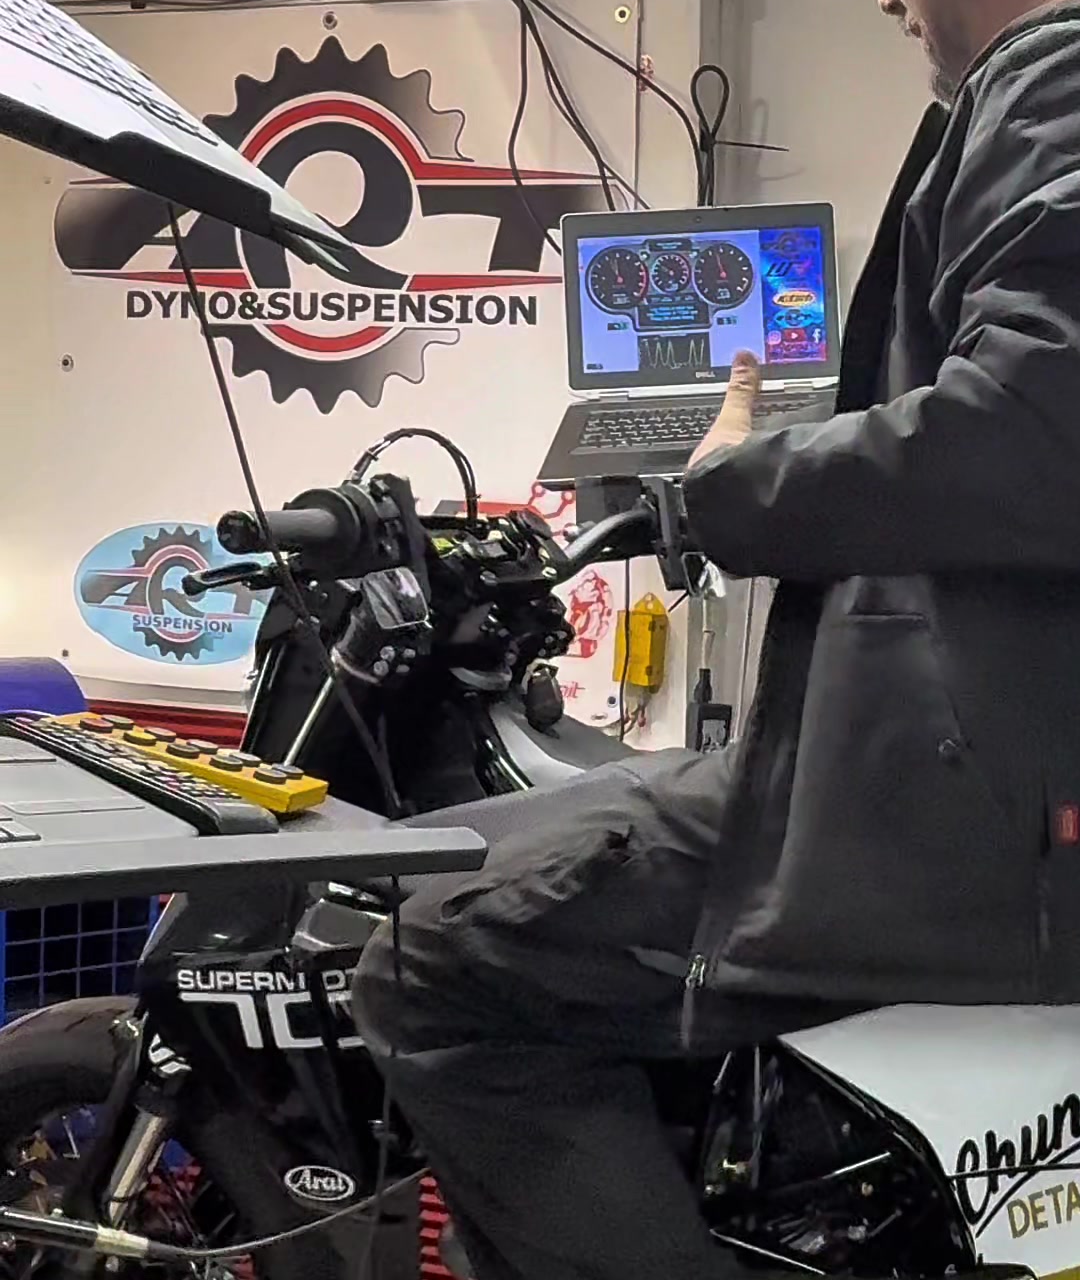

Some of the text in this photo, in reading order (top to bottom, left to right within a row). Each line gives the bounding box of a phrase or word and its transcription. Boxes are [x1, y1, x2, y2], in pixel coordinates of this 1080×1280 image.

[126, 289, 538, 325] DYNO&SUSPENSION
[131, 613, 233, 633] SUSPENSION
[295, 1168, 347, 1192] Arai
